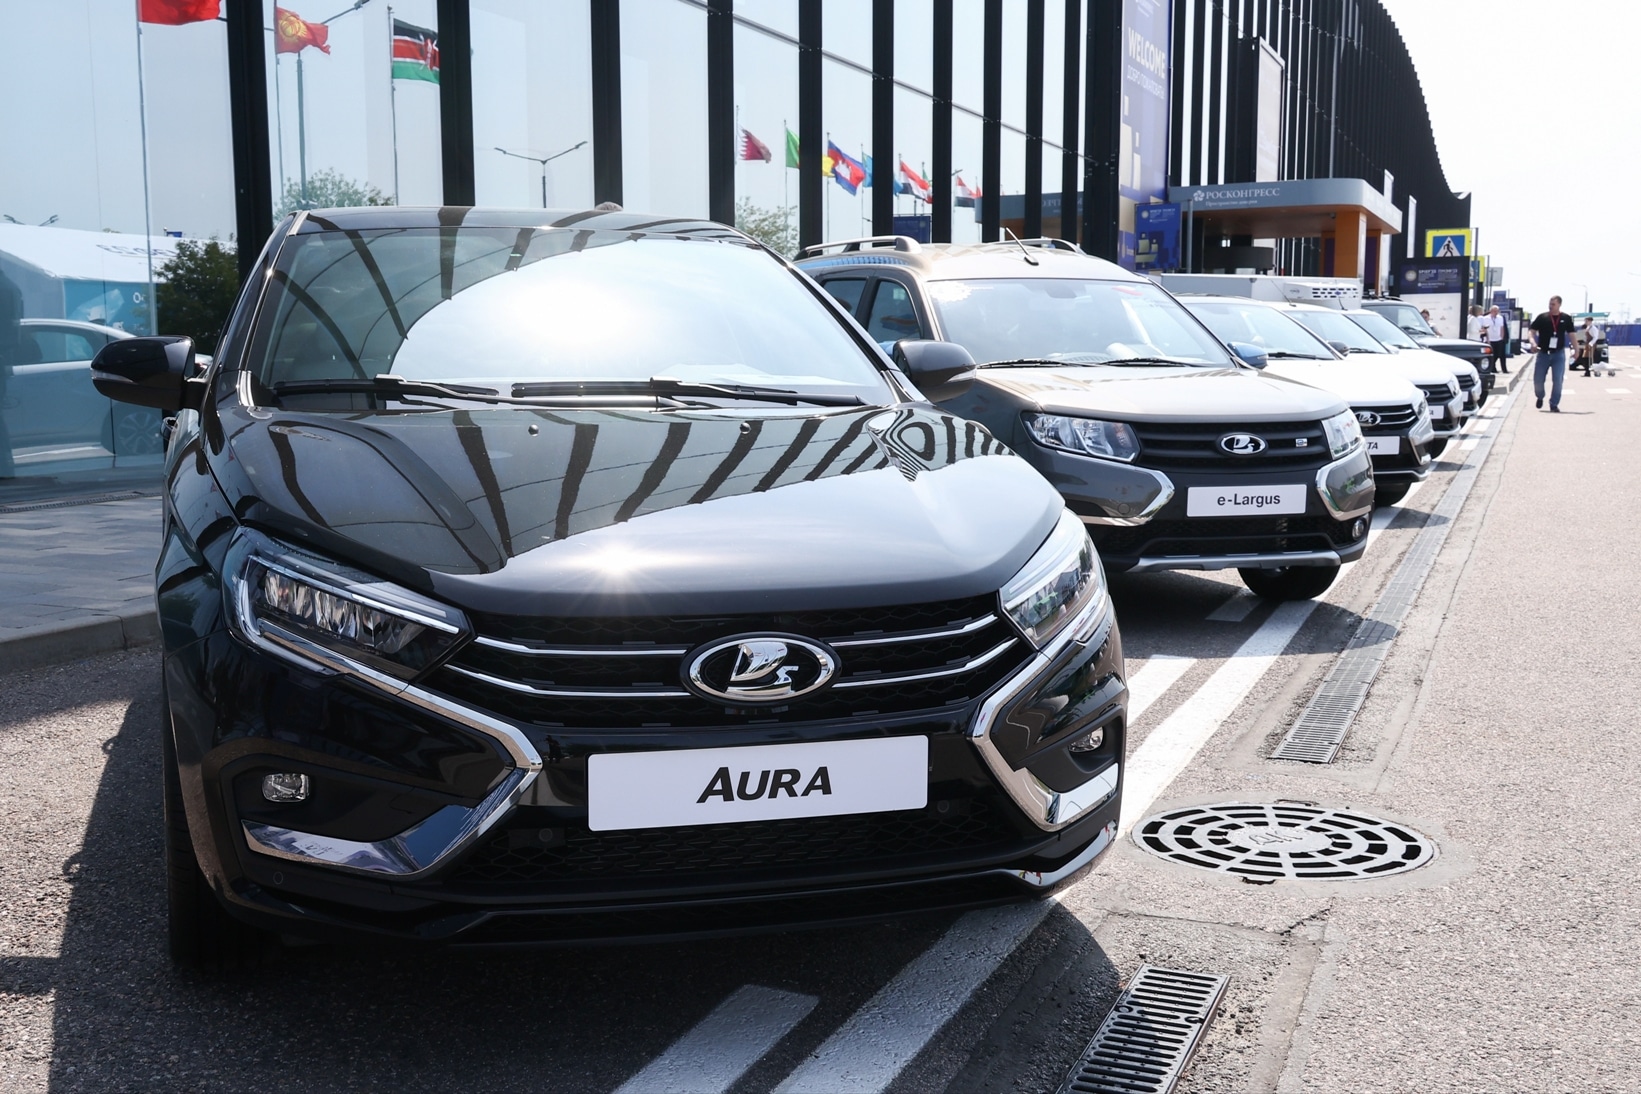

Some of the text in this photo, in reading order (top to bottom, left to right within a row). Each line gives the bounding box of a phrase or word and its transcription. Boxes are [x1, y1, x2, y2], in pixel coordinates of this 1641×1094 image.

[1128, 26, 1165, 79] WELCOME
[1206, 187, 1280, 200] РОСКОНГРЕСС
[1217, 493, 1281, 508] e-Largus
[696, 766, 832, 803] AURA
